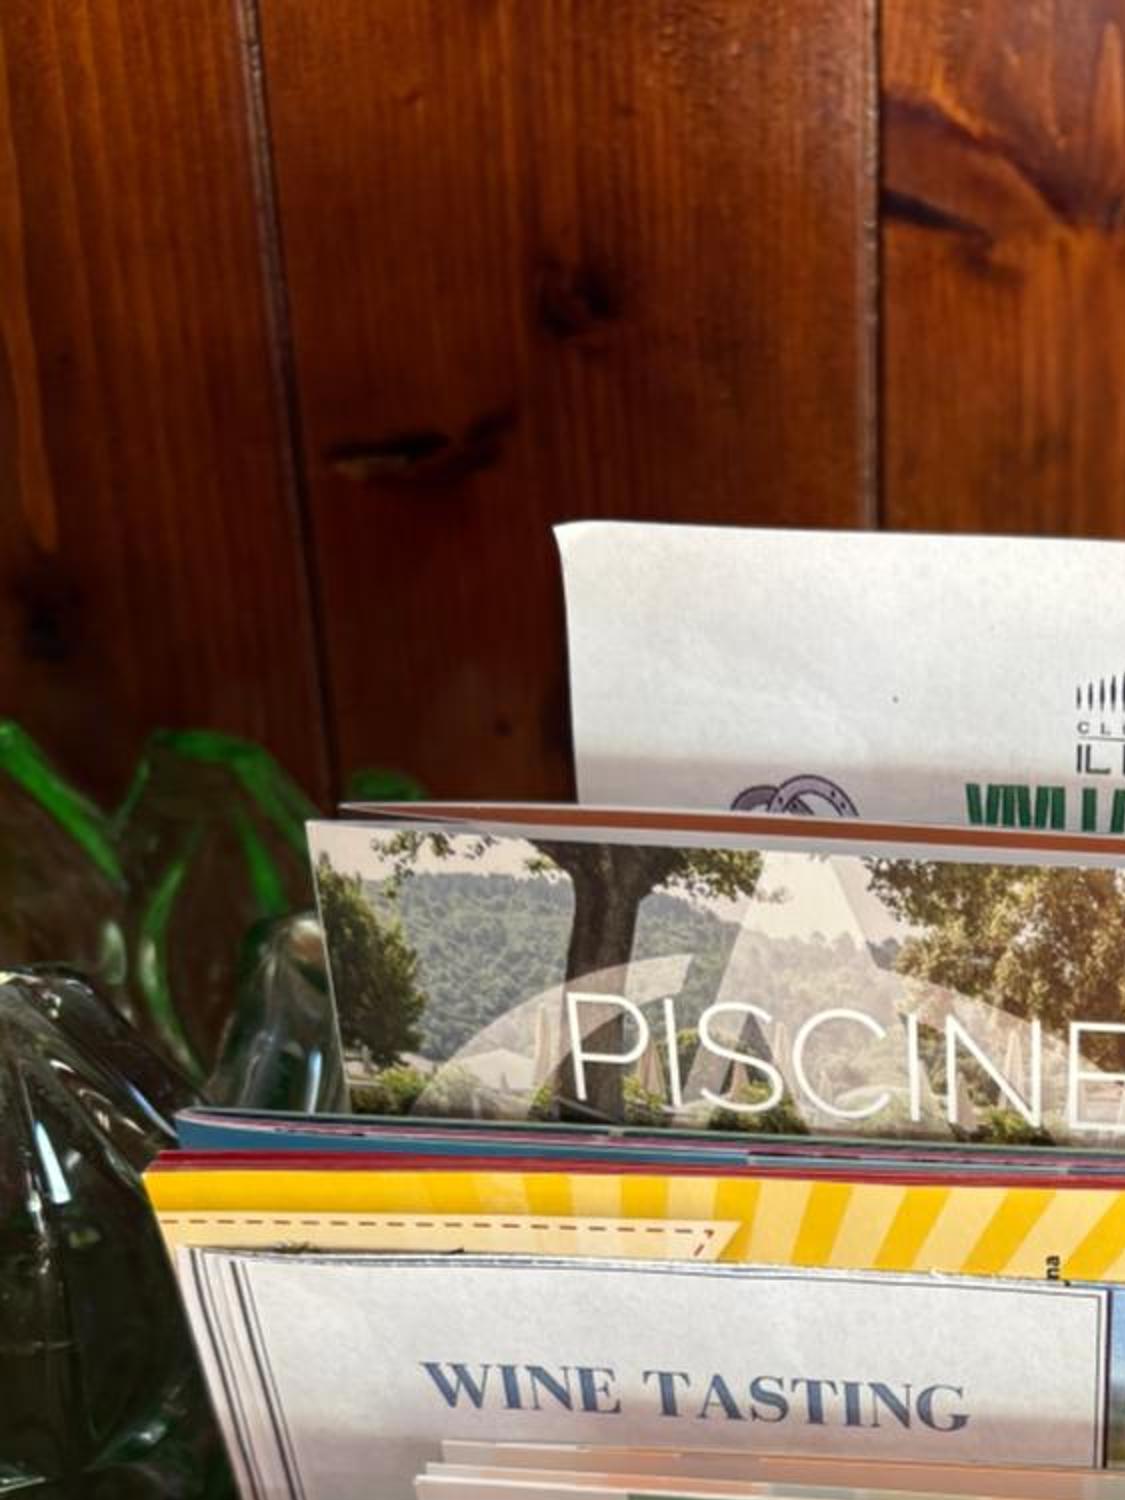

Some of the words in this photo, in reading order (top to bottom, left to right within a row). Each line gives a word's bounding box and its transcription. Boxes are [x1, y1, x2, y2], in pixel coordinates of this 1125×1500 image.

[1076, 743, 1112, 776] IL
[418, 1359, 623, 1416] WINE
[640, 1367, 972, 1434] TASTING
